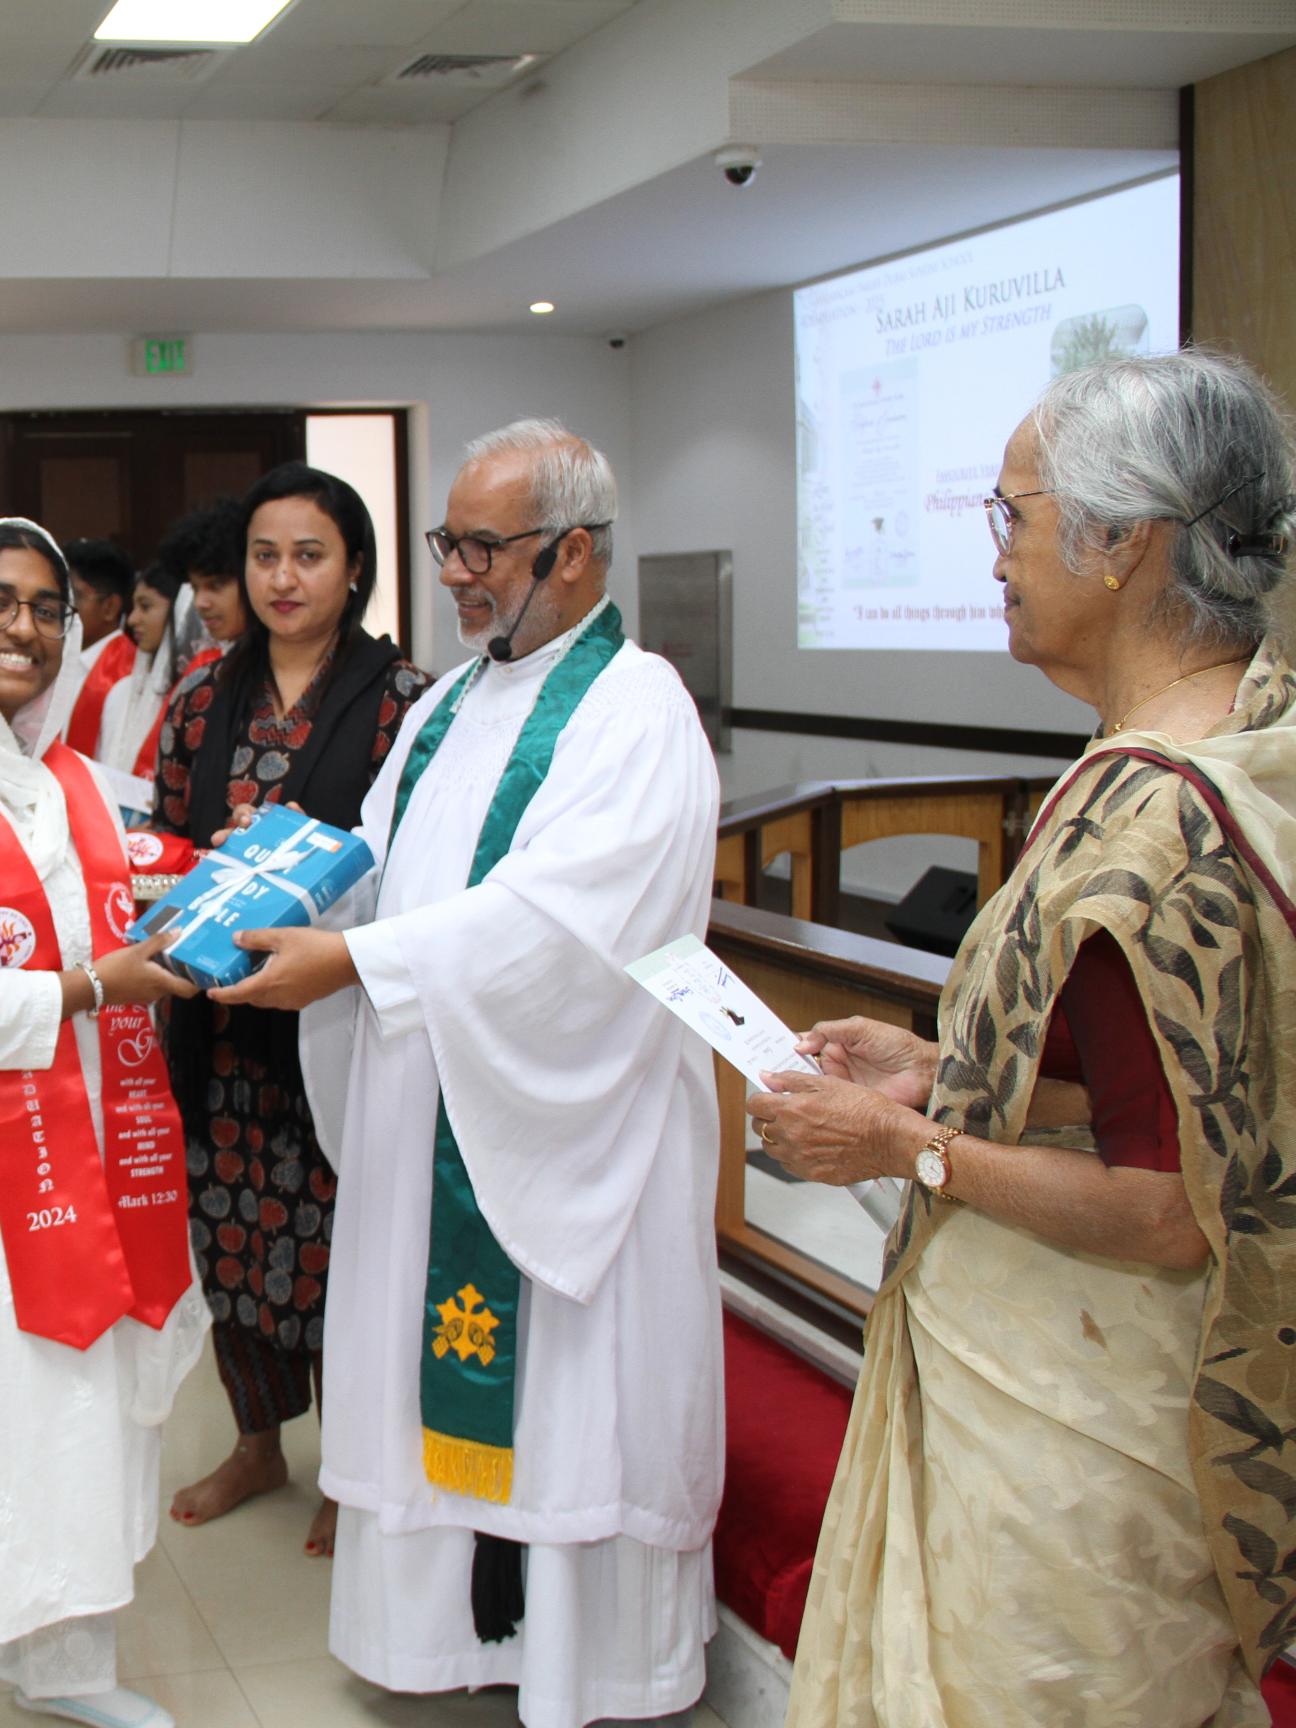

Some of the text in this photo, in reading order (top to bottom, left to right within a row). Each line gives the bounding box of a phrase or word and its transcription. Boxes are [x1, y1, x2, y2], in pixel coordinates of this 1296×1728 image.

[876, 302, 926, 334] SARAH
[932, 294, 955, 320] AJI
[964, 268, 1066, 311] KURUVILLA
[885, 337, 906, 357] THE
[910, 331, 941, 351] LORD
[961, 321, 978, 338] MY
[981, 303, 1052, 335] STRENGTH
[108, 1016, 145, 1036] your
[130, 1165, 164, 1178] STRENGTH
[118, 1190, 177, 1209] Mark 12:30
[27, 1205, 77, 1232] 2024
